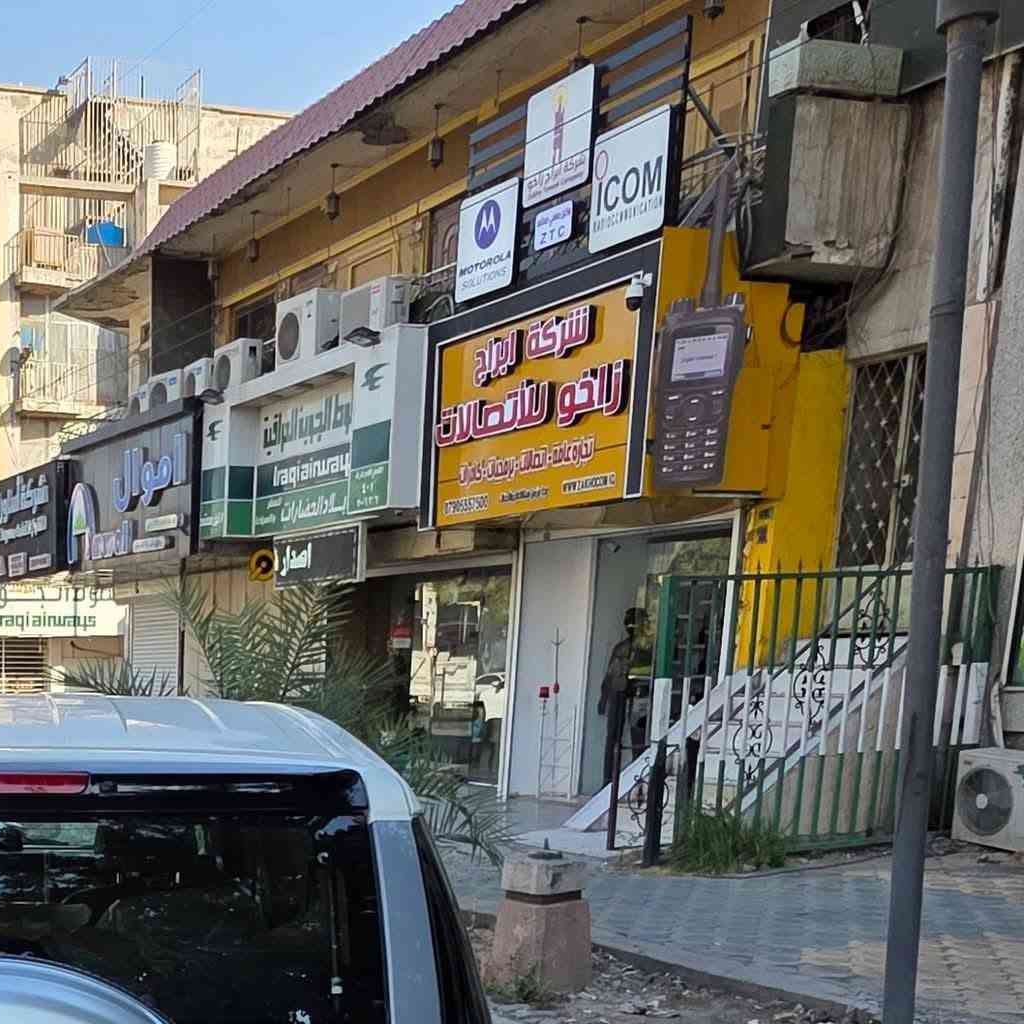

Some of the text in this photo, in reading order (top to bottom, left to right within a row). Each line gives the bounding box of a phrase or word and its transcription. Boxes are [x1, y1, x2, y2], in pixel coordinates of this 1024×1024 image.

[458, 250, 511, 277] MOTOROLA
[462, 266, 508, 290] SOLUTIONS
[473, 305, 590, 388] شركة ابراج
[557, 360, 624, 428] زاخو
